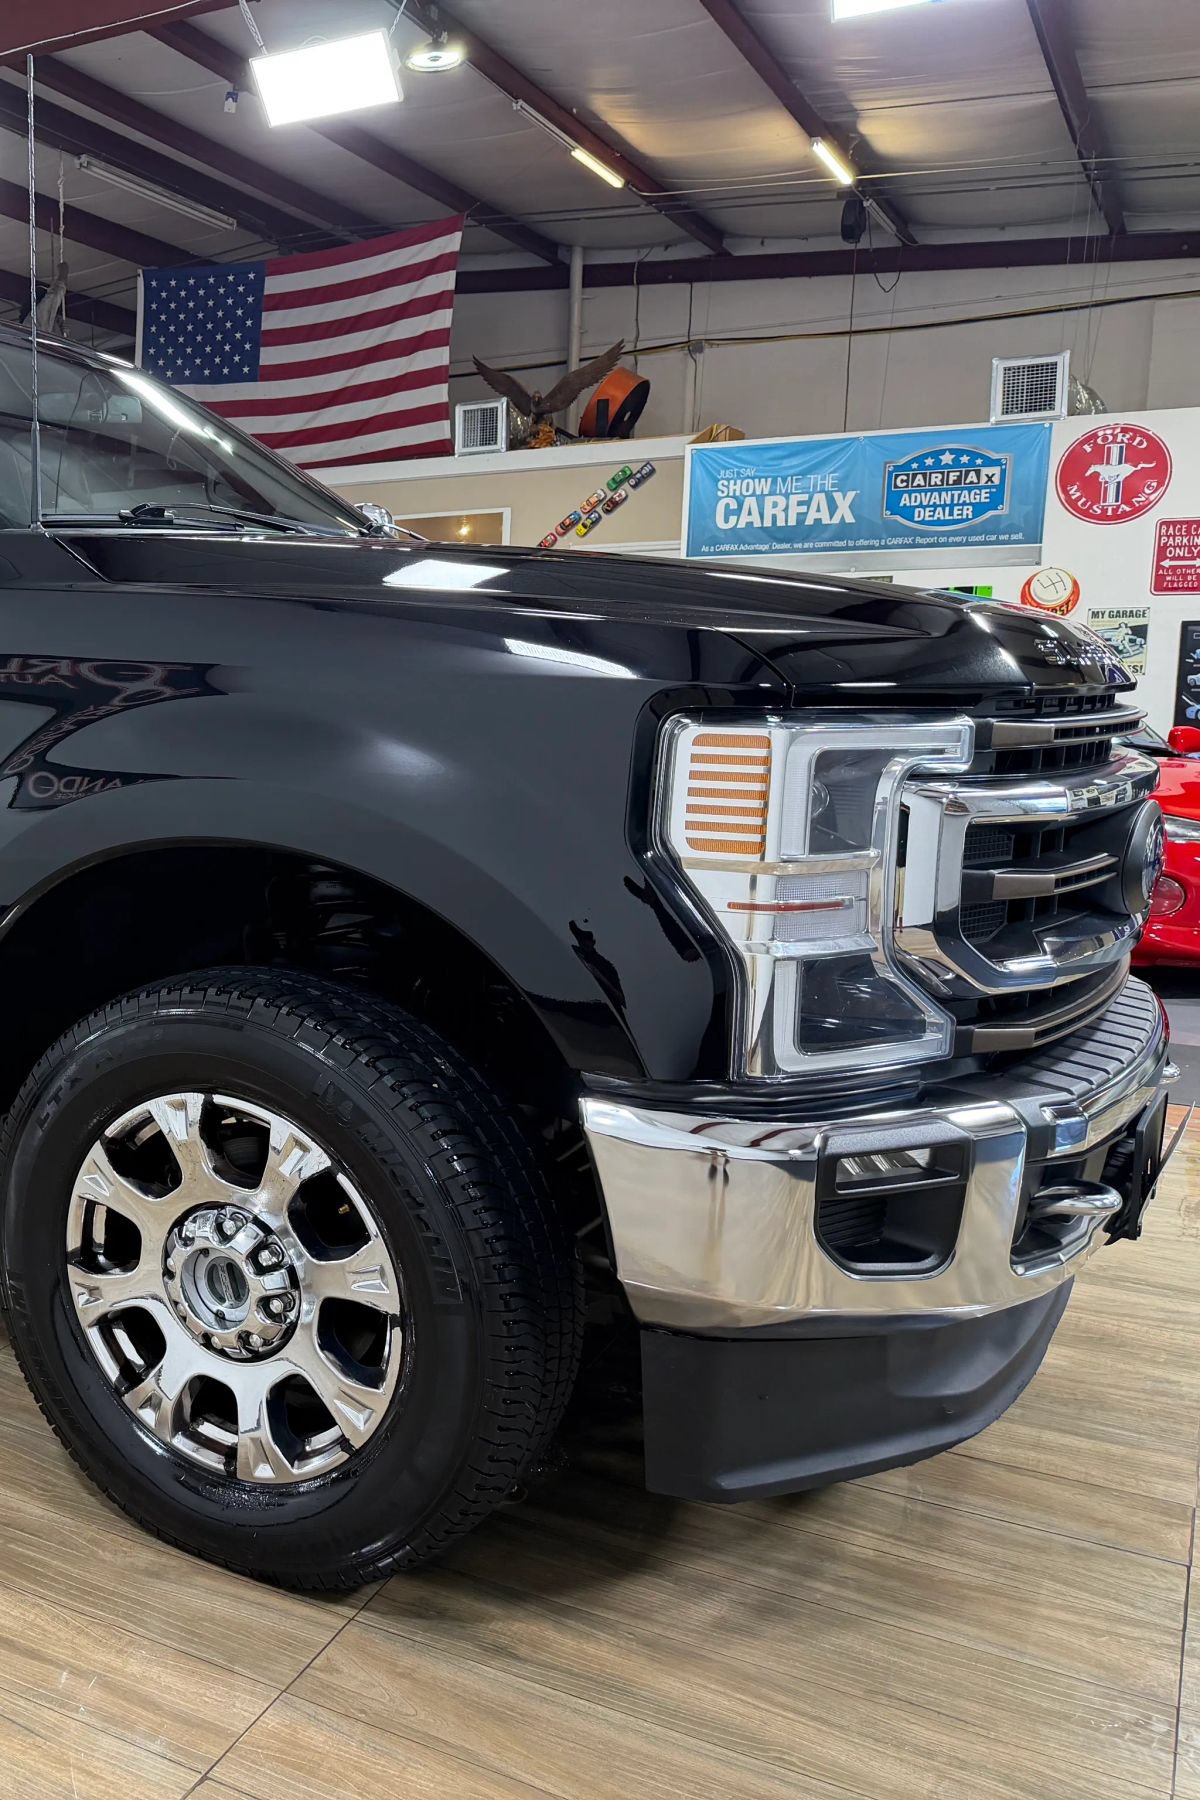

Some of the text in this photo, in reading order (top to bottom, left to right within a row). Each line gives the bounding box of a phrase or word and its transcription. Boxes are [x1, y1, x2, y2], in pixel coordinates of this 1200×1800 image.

[1082, 432, 1148, 454] FORD
[717, 467, 756, 479] JUST SAY
[895, 470, 996, 488] CARFAX
[717, 473, 839, 497] SHOW ME THE
[899, 489, 991, 507] ADVANTAGE
[1067, 479, 1158, 516] MUSTANG
[715, 491, 856, 530] CARFAX
[913, 506, 973, 522] DEALER
[1160, 524, 1188, 536] RACE
[715, 544, 738, 552] CARFAX
[814, 539, 846, 549] committed
[855, 538, 879, 549] offering
[916, 536, 938, 546] Report
[949, 535, 968, 544] every
[968, 533, 985, 542] used
[1010, 532, 1024, 541] sell.
[1160, 535, 1200, 547] PARKIN
[1166, 546, 1200, 557] ONLY
[1090, 609, 1148, 619] MY GARAGE
